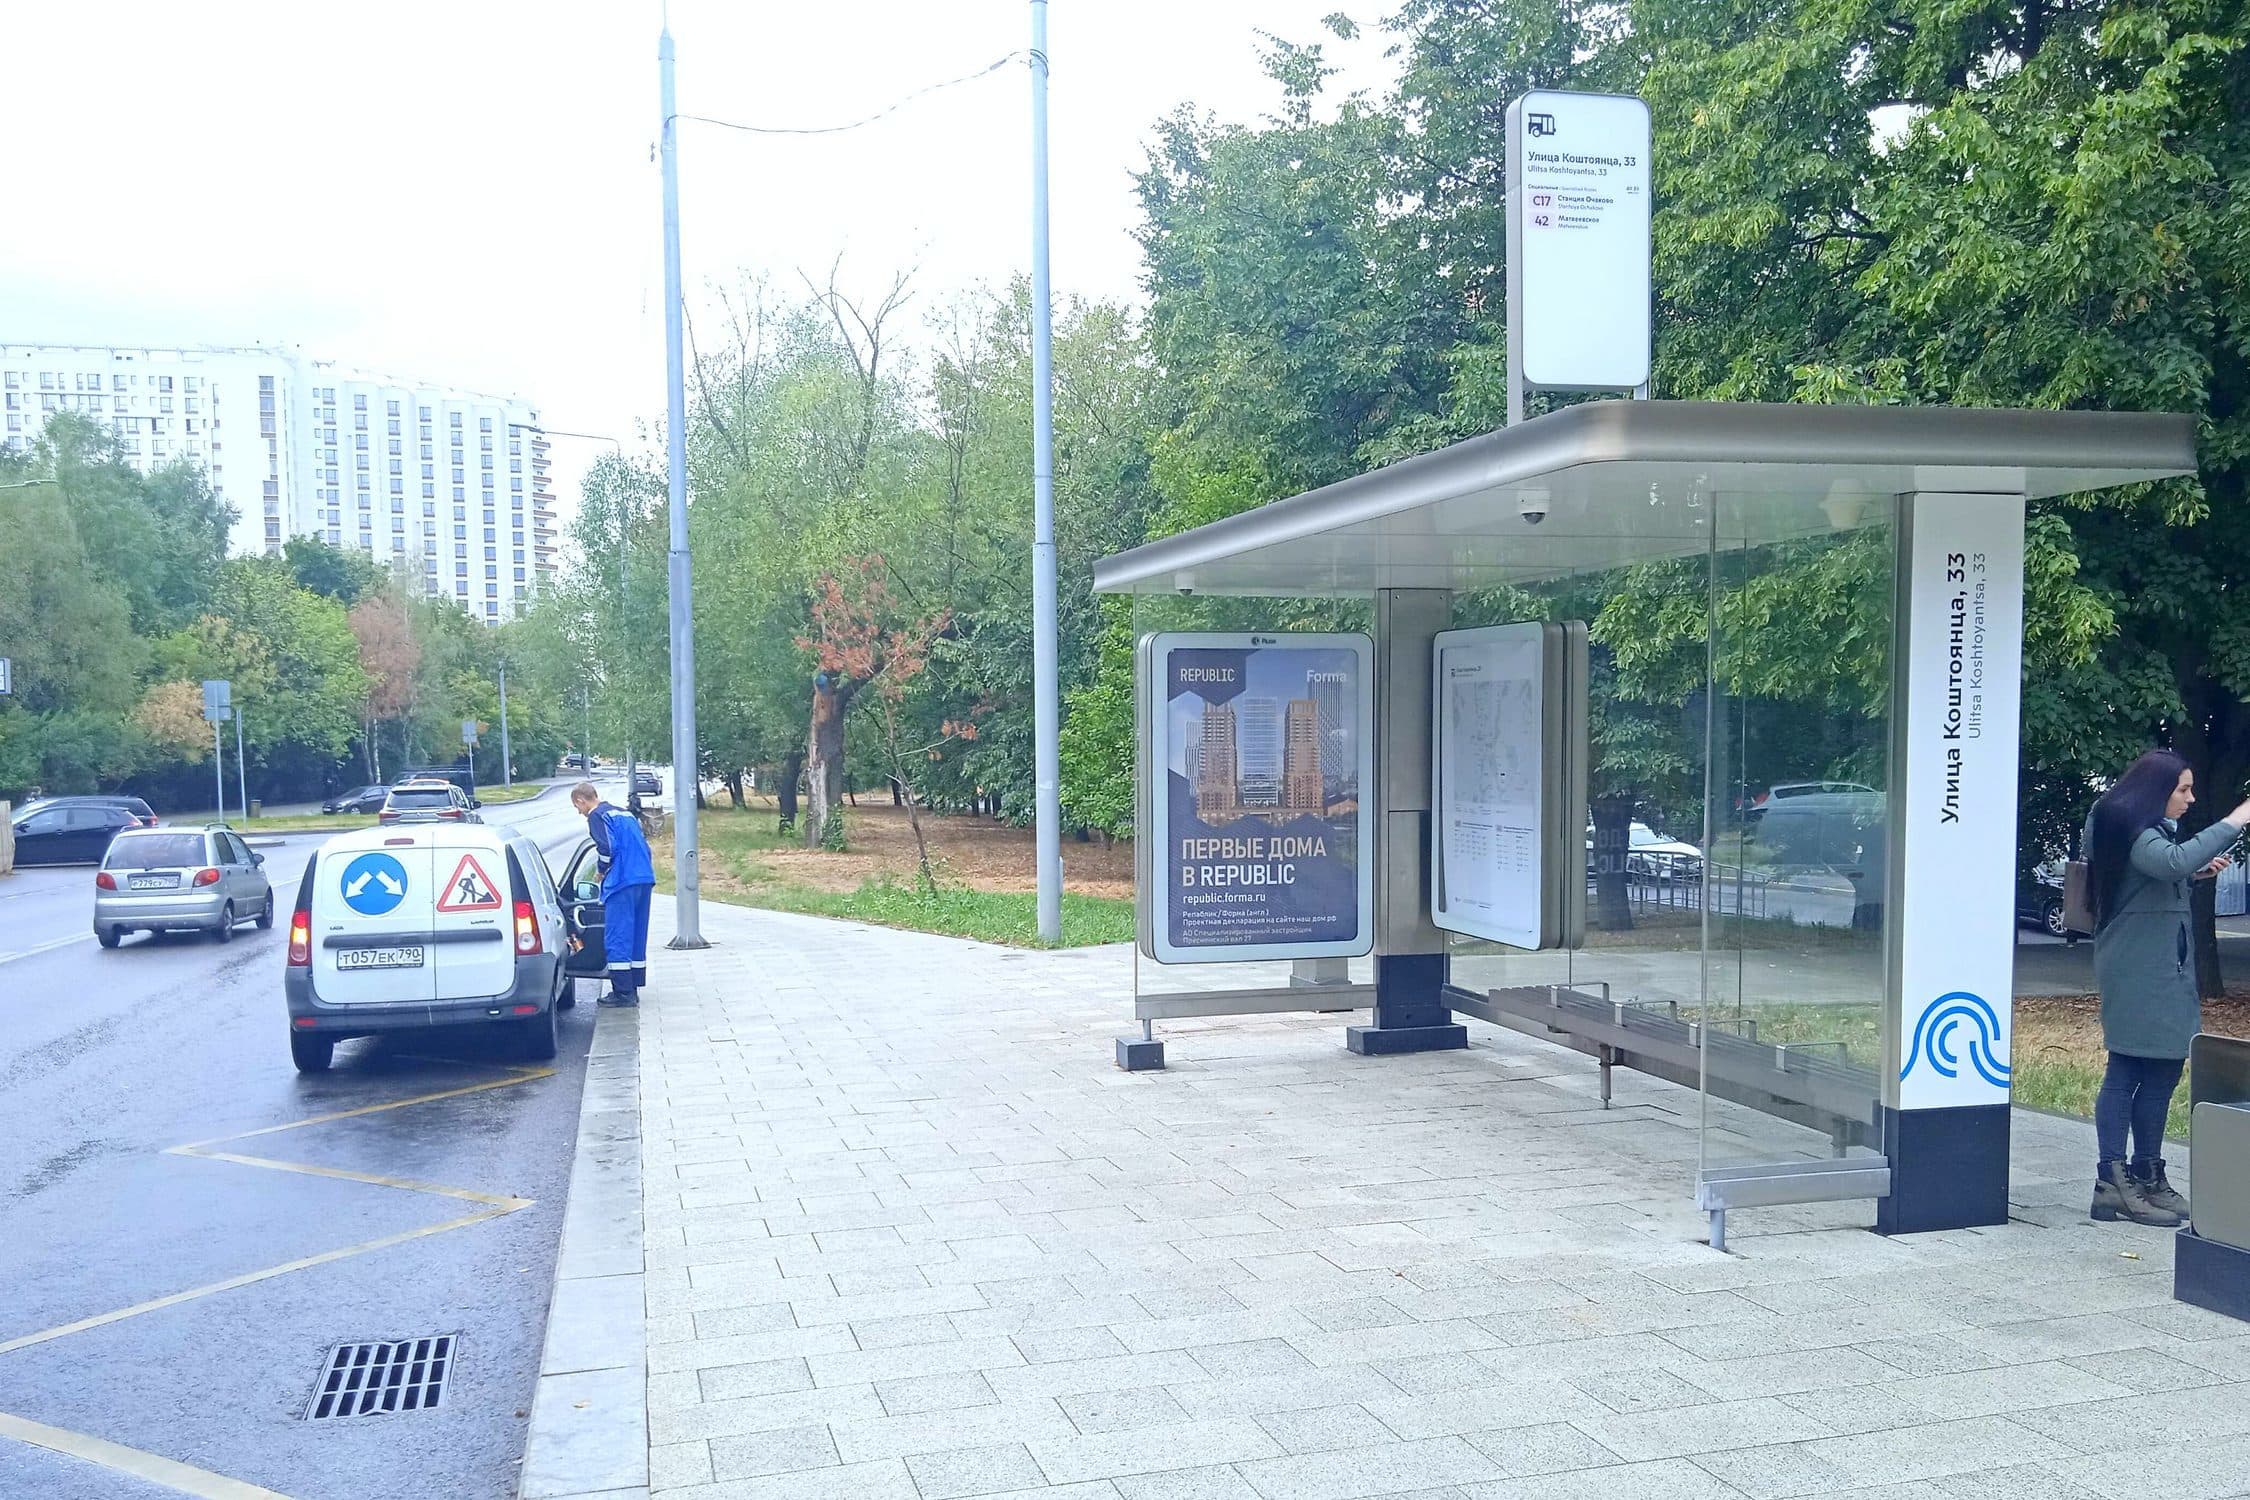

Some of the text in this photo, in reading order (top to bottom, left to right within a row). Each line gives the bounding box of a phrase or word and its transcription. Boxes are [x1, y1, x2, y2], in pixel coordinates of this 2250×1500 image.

[1528, 151, 1636, 167] Улица Коштоянца, 33
[1528, 165, 1548, 173] Ulitsa
[1598, 168, 1607, 176] 33
[1557, 195, 1584, 203] Станция
[1535, 215, 1549, 226] 42
[1969, 553, 1986, 739] Ulitsa Koshtoyantsa, 33
[1180, 668, 1235, 682] REPUBLIC
[1306, 669, 1347, 683] Forma
[1941, 553, 1967, 823] Улица Коштоянца, 33
[1182, 836, 1327, 861] ПЕРВЫЕ ДОМА
[1201, 864, 1296, 887] REPUBLIC
[1183, 892, 1266, 906] republic.forma.ru
[1183, 918, 1222, 927] Проектная
[1222, 917, 1265, 926] декларация
[1275, 915, 1295, 923] сайте
